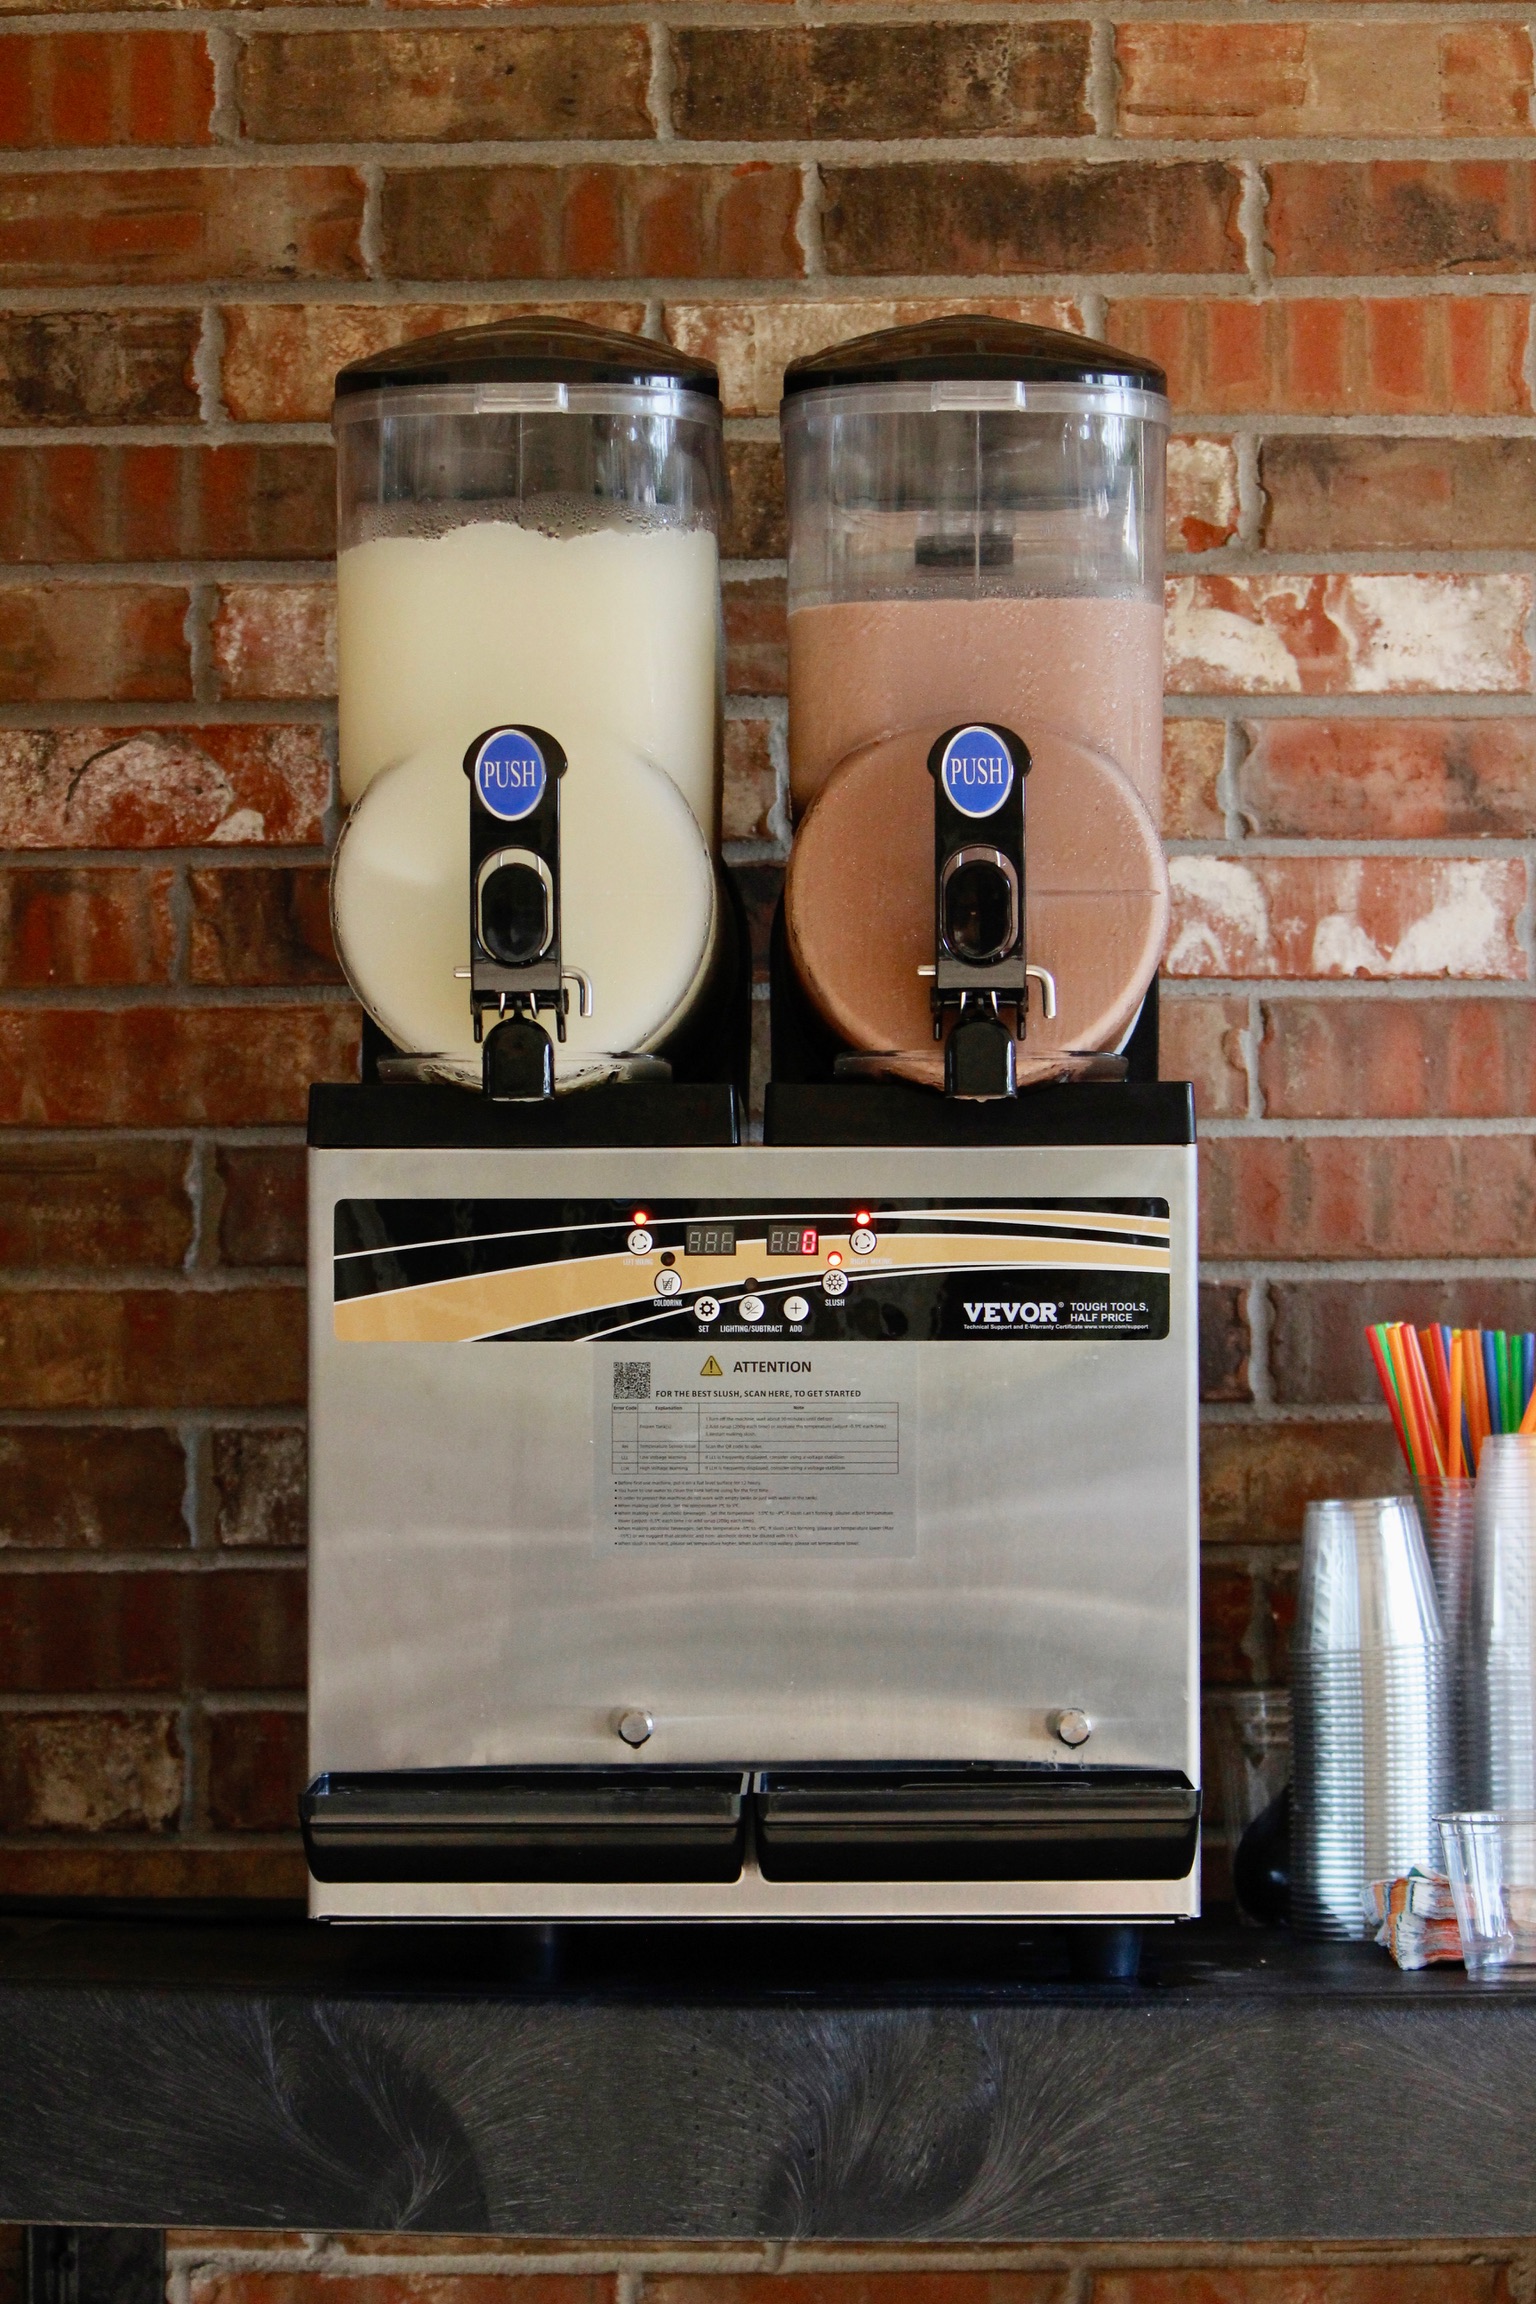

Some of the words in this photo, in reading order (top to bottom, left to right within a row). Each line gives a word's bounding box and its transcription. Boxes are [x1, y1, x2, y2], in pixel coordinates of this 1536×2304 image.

[483, 760, 536, 788] PUSH
[950, 757, 1003, 785] PUSH
[623, 1258, 635, 1266] LEFT
[824, 1299, 845, 1307] SLUSH
[1070, 1302, 1107, 1312] TOUGH
[1110, 1302, 1149, 1312] TOOLS,
[1070, 1313, 1098, 1322] HALF
[1101, 1313, 1133, 1322] PRICE
[698, 1325, 710, 1333] SET
[720, 1325, 783, 1333] LIGHTING/SUBTRACT
[789, 1325, 803, 1333] ADD
[733, 1361, 812, 1373] ATTENTION
[655, 1390, 673, 1398] FOR
[674, 1390, 690, 1398] THE
[692, 1390, 712, 1398] BEST
[713, 1390, 743, 1398] SLUSH,
[744, 1390, 766, 1398] SCAN
[768, 1390, 793, 1398] HERE,
[794, 1390, 806, 1398] TO
[807, 1390, 823, 1398] GET
[825, 1390, 861, 1398] STARTED
